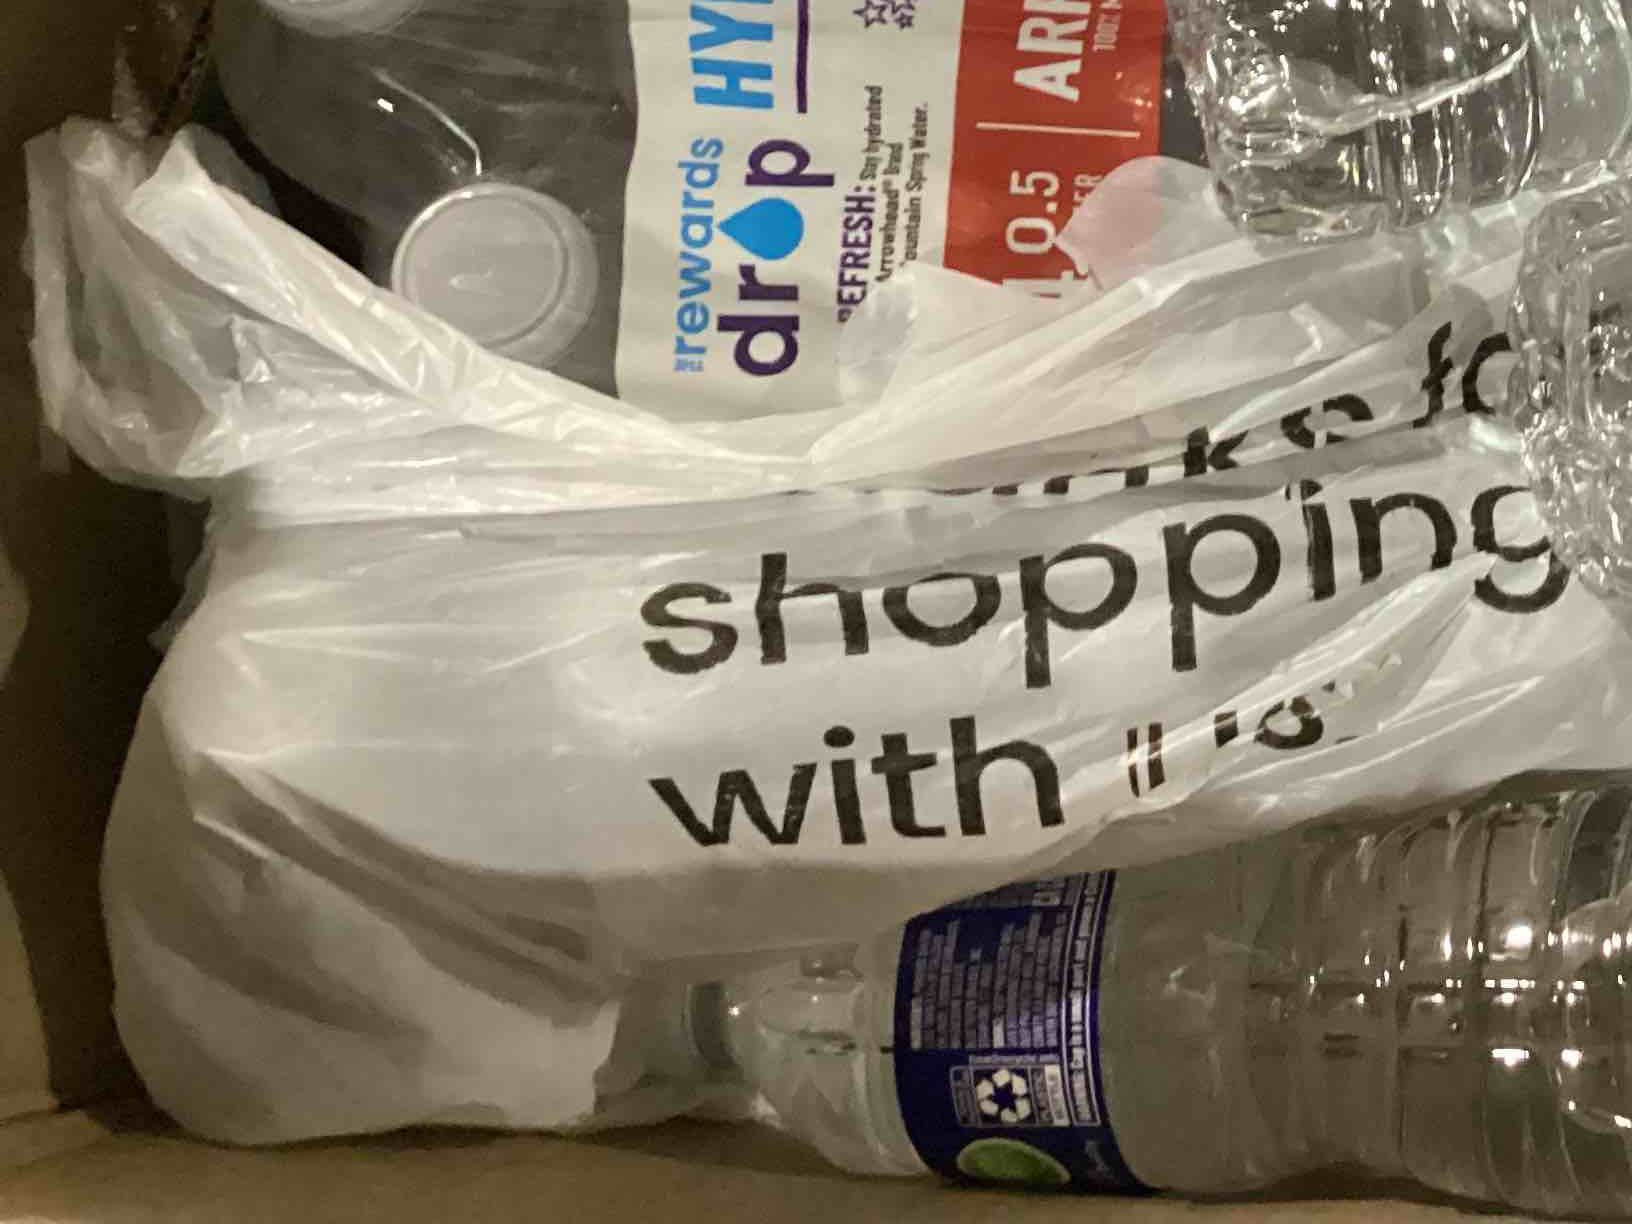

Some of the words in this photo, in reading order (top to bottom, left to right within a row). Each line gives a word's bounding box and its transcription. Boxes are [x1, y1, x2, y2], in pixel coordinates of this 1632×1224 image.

[864, 85, 885, 153] hydrated
[673, 137, 722, 357] rewards
[901, 198, 922, 264] ountain
[640, 479, 1571, 689] shopping
[650, 716, 1065, 847] with
